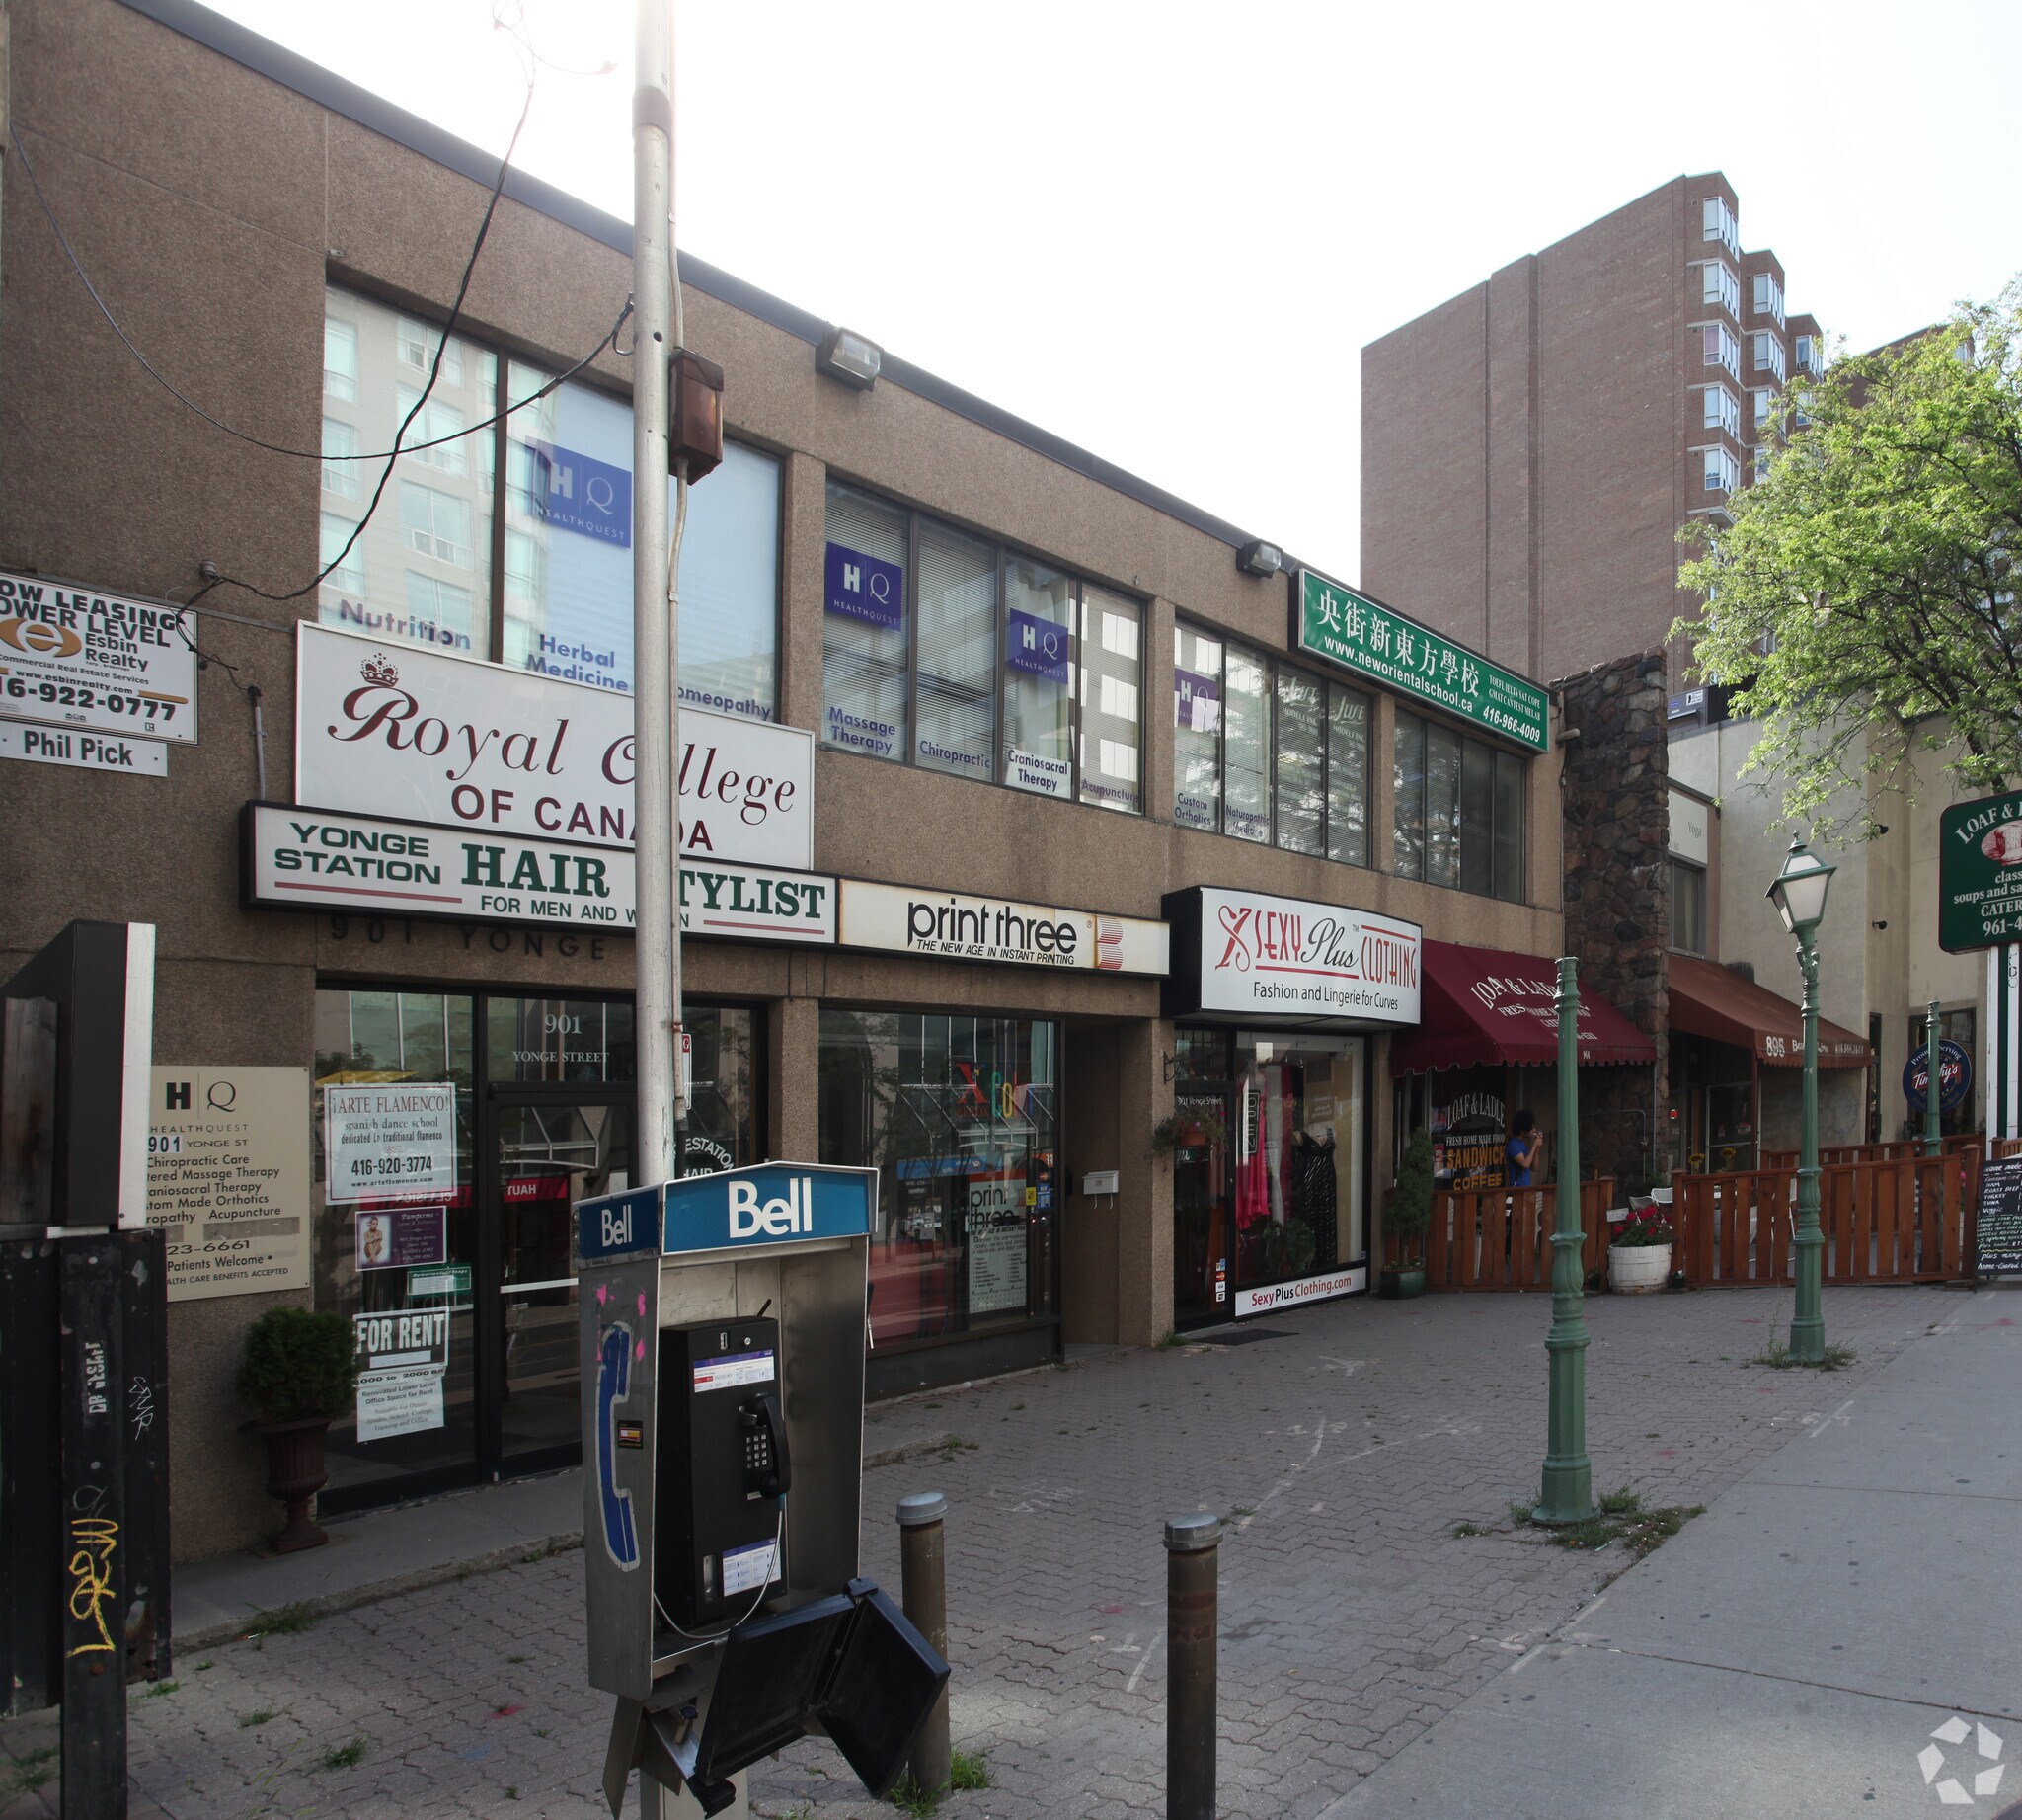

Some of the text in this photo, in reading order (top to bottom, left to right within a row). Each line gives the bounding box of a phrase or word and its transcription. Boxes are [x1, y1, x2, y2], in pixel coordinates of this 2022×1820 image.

[536, 506, 626, 540] HEALTHQUEST
[55, 591, 177, 631] LEASING
[833, 598, 897, 625] HEALTHQUEST
[87, 614, 171, 648] LEVEL
[341, 598, 471, 651] Nutrition
[85, 632, 138, 655] Esbin
[539, 634, 615, 669] Herbal
[85, 647, 149, 673] Realty
[525, 654, 629, 692] Medicine
[1015, 657, 1065, 678] HEALTHQUEST
[16, 669, 133, 695] www.esbinrealty.com
[57, 663, 77, 673] Real
[80, 667, 111, 679] Estate
[112, 673, 150, 686] Services
[1324, 634, 1473, 713] www.neworientalschool.ca
[1489, 674, 1505, 691] TOEFL
[1505, 682, 1518, 698] IELTS
[0, 676, 176, 722] 6-922-0777
[677, 687, 772, 722] omeopathy
[1489, 688, 1540, 721] GMAT CANTEST MELAB
[828, 707, 896, 737] Massage
[1483, 705, 1540, 743] 416-966-4009
[24, 730, 134, 767] Phil Pick
[831, 725, 893, 755] Therapy
[327, 685, 796, 826] Royal Cllege
[919, 741, 991, 769] Chiropractic
[1008, 749, 1068, 775] Craniosacral
[1017, 768, 1057, 793] Therapy
[1177, 792, 1207, 811] Custom
[451, 784, 714, 851] OF CANA
[1174, 806, 1211, 826] Orthotics
[1225, 804, 1271, 826] Naturopathic
[1955, 803, 2014, 845] LOAF &
[290, 822, 429, 858] YONGE
[274, 848, 440, 885] STATION
[461, 842, 826, 919] HAIR TYLIST
[1954, 883, 2008, 905] soups and
[481, 895, 521, 914] FOR
[530, 900, 572, 919] MEN
[581, 906, 618, 922] AND
[907, 897, 1077, 955] print three
[457, 925, 605, 961] YONGE
[916, 939, 1075, 966] THE NEW AGE IN INSTANT PRINTING
[1255, 910, 1417, 989] SEXY Plus CLOTHING
[1253, 982, 1398, 1010] Fashion and Lingerie for Curves
[544, 1013, 582, 1035] 901
[513, 1051, 609, 1064] YONGE STREET
[1765, 1035, 1785, 1058] 895
[376, 1095, 449, 1113] FLAMENCO!
[1447, 1092, 1506, 1131] LOAF & LADLE
[150, 1124, 249, 1134] HEALTHQUEST
[342, 1130, 443, 1145] dedicated traditional flamenco
[345, 1116, 438, 1133] spanish dance school
[148, 1136, 181, 1153] 901
[187, 1139, 230, 1147] YONGE
[1446, 1135, 1462, 1147] FRESH
[1463, 1135, 1478, 1146] HOME
[1493, 1133, 1506, 1144] FOOD
[147, 1154, 250, 1170] Chiropractic Care
[182, 1166, 280, 1182] Massage Therapy
[351, 1155, 433, 1176] 416-920-3774
[147, 1182, 262, 1197] aniosacral Therapy
[351, 1176, 433, 1187] www.arteflamenco.com
[1453, 1172, 1503, 1191] COFFEE
[178, 1193, 270, 1209] Made Orthotics
[728, 1177, 813, 1239] Bell
[146, 1206, 281, 1227] ropathy Acupuncture
[601, 1204, 632, 1247] Bell
[167, 1240, 250, 1255] 23-6661
[1981, 1252, 1998, 1261] plus
[167, 1256, 264, 1272] Patients Welcome
[167, 1267, 288, 1286] ALTH CARE BENEFITS ACCEPTED
[1251, 1275, 1352, 1306] SexyPlusClothing.com
[355, 1314, 444, 1354] FOR RENT
[402, 1370, 429, 1379] 2000
[361, 1387, 397, 1398] Renovated
[365, 1396, 386, 1405] Office
[387, 1393, 408, 1402] Space
